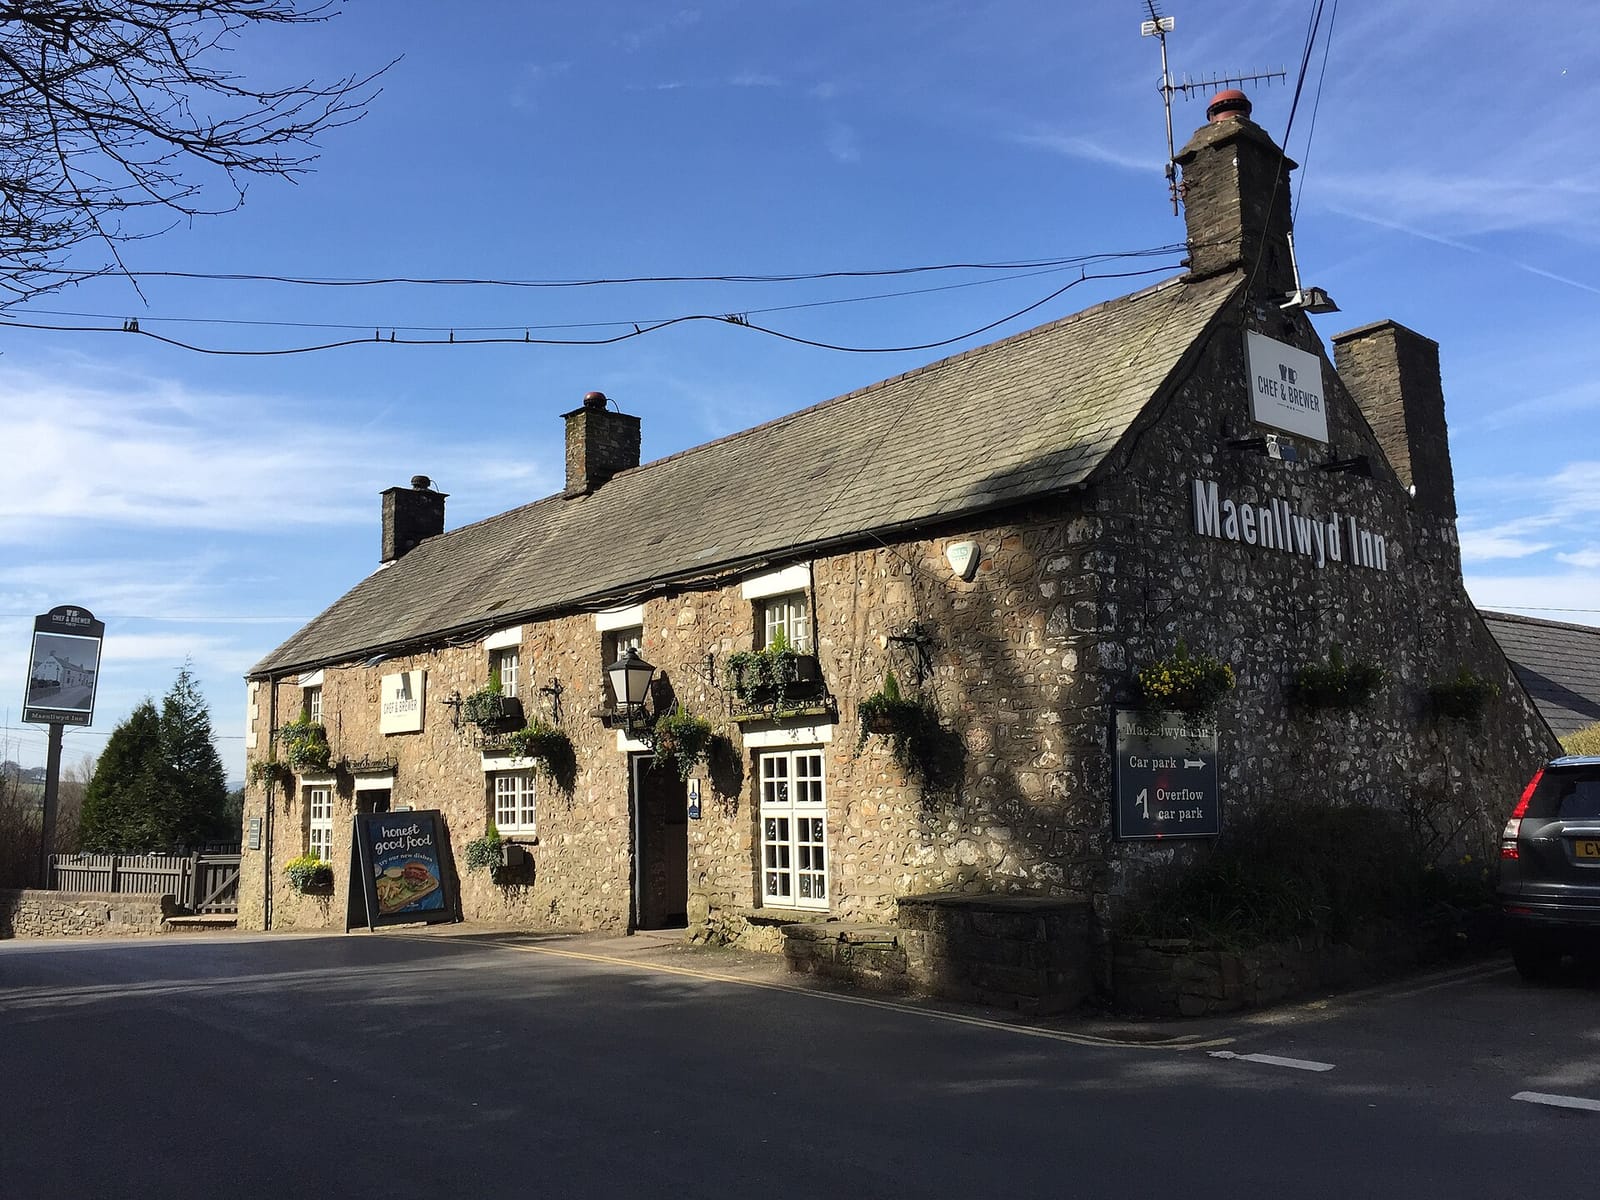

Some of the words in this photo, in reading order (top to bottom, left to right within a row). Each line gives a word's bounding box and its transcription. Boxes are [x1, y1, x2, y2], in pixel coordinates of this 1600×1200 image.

[1258, 376, 1278, 398] CHEF
[1280, 383, 1287, 401] &
[1288, 386, 1320, 413] BREWER
[1192, 479, 1342, 569] Maenllwyd
[1347, 516, 1387, 571] Inn
[52, 614, 66, 622] CHEF
[70, 616, 91, 625] BREWER
[384, 701, 395, 714] CHEF
[399, 699, 418, 712] BREWER
[1129, 755, 1149, 768] Car
[1152, 756, 1177, 771] park
[1156, 788, 1204, 801] Overflow
[1158, 810, 1175, 819] car
[1178, 807, 1203, 822] park
[381, 823, 420, 838] honest
[375, 839, 405, 855] good
[406, 834, 433, 852] food
[413, 852, 433, 862] dishes
